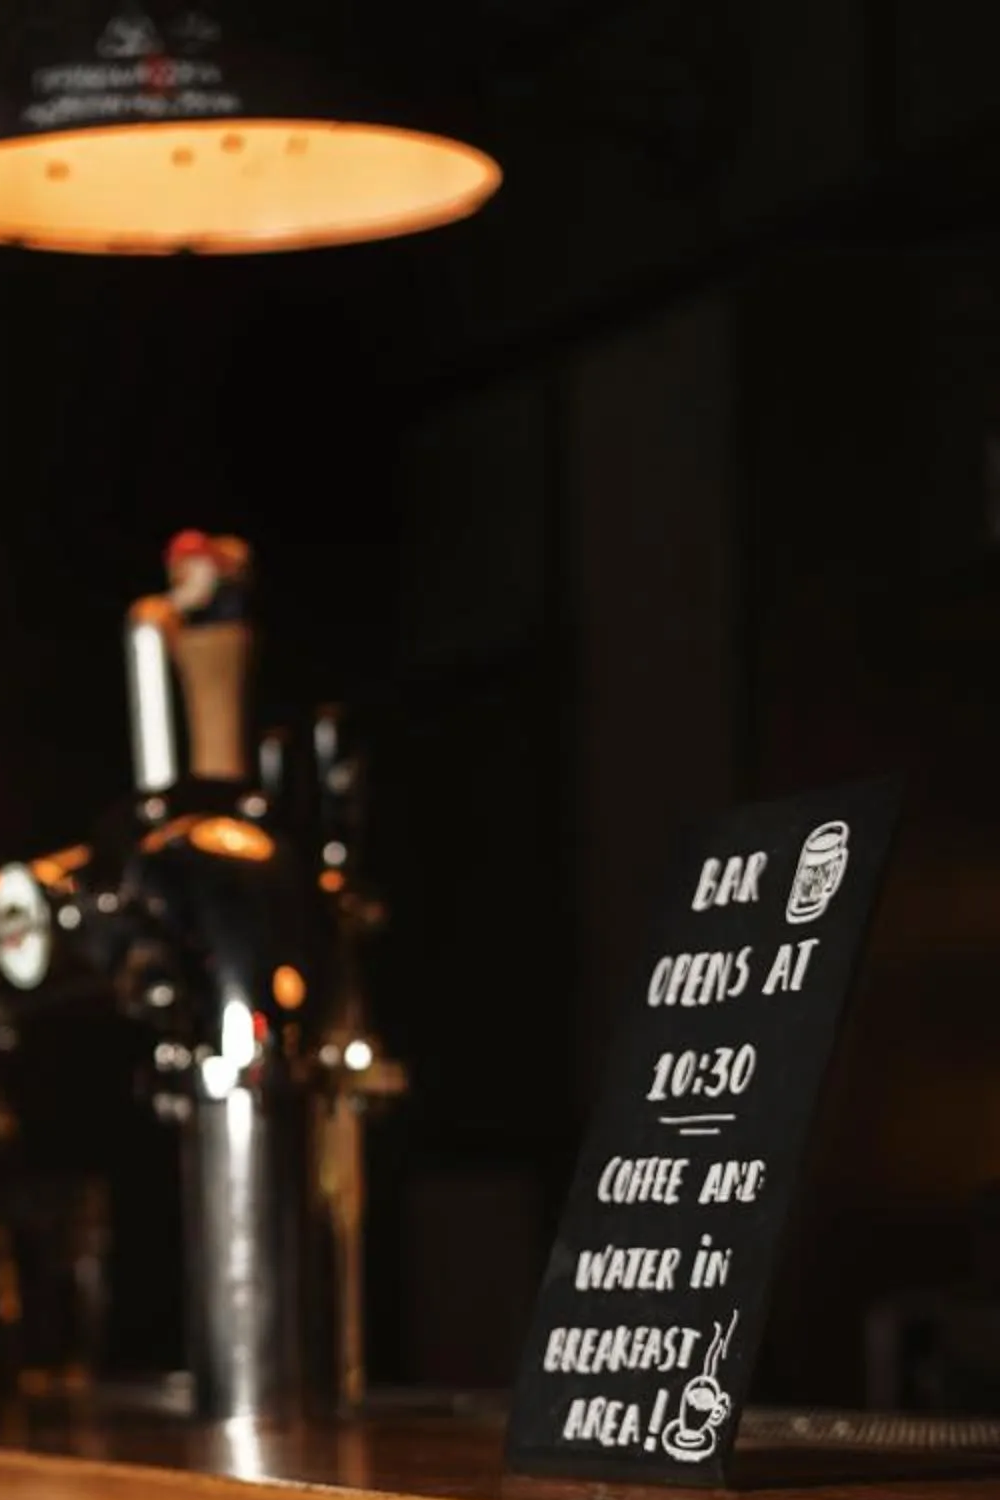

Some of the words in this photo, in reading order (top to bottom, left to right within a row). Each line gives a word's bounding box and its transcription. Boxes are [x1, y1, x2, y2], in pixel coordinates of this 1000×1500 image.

[691, 851, 768, 911] BAR
[648, 946, 753, 1007] OPENS
[762, 938, 820, 995] AT
[646, 1043, 756, 1100] 10:30
[598, 1156, 690, 1204] COFFEE
[698, 1160, 766, 1204] AND
[575, 1244, 681, 1291] WATER
[544, 1325, 701, 1374] BREAKFAST
[563, 1388, 669, 1451] AREA!
